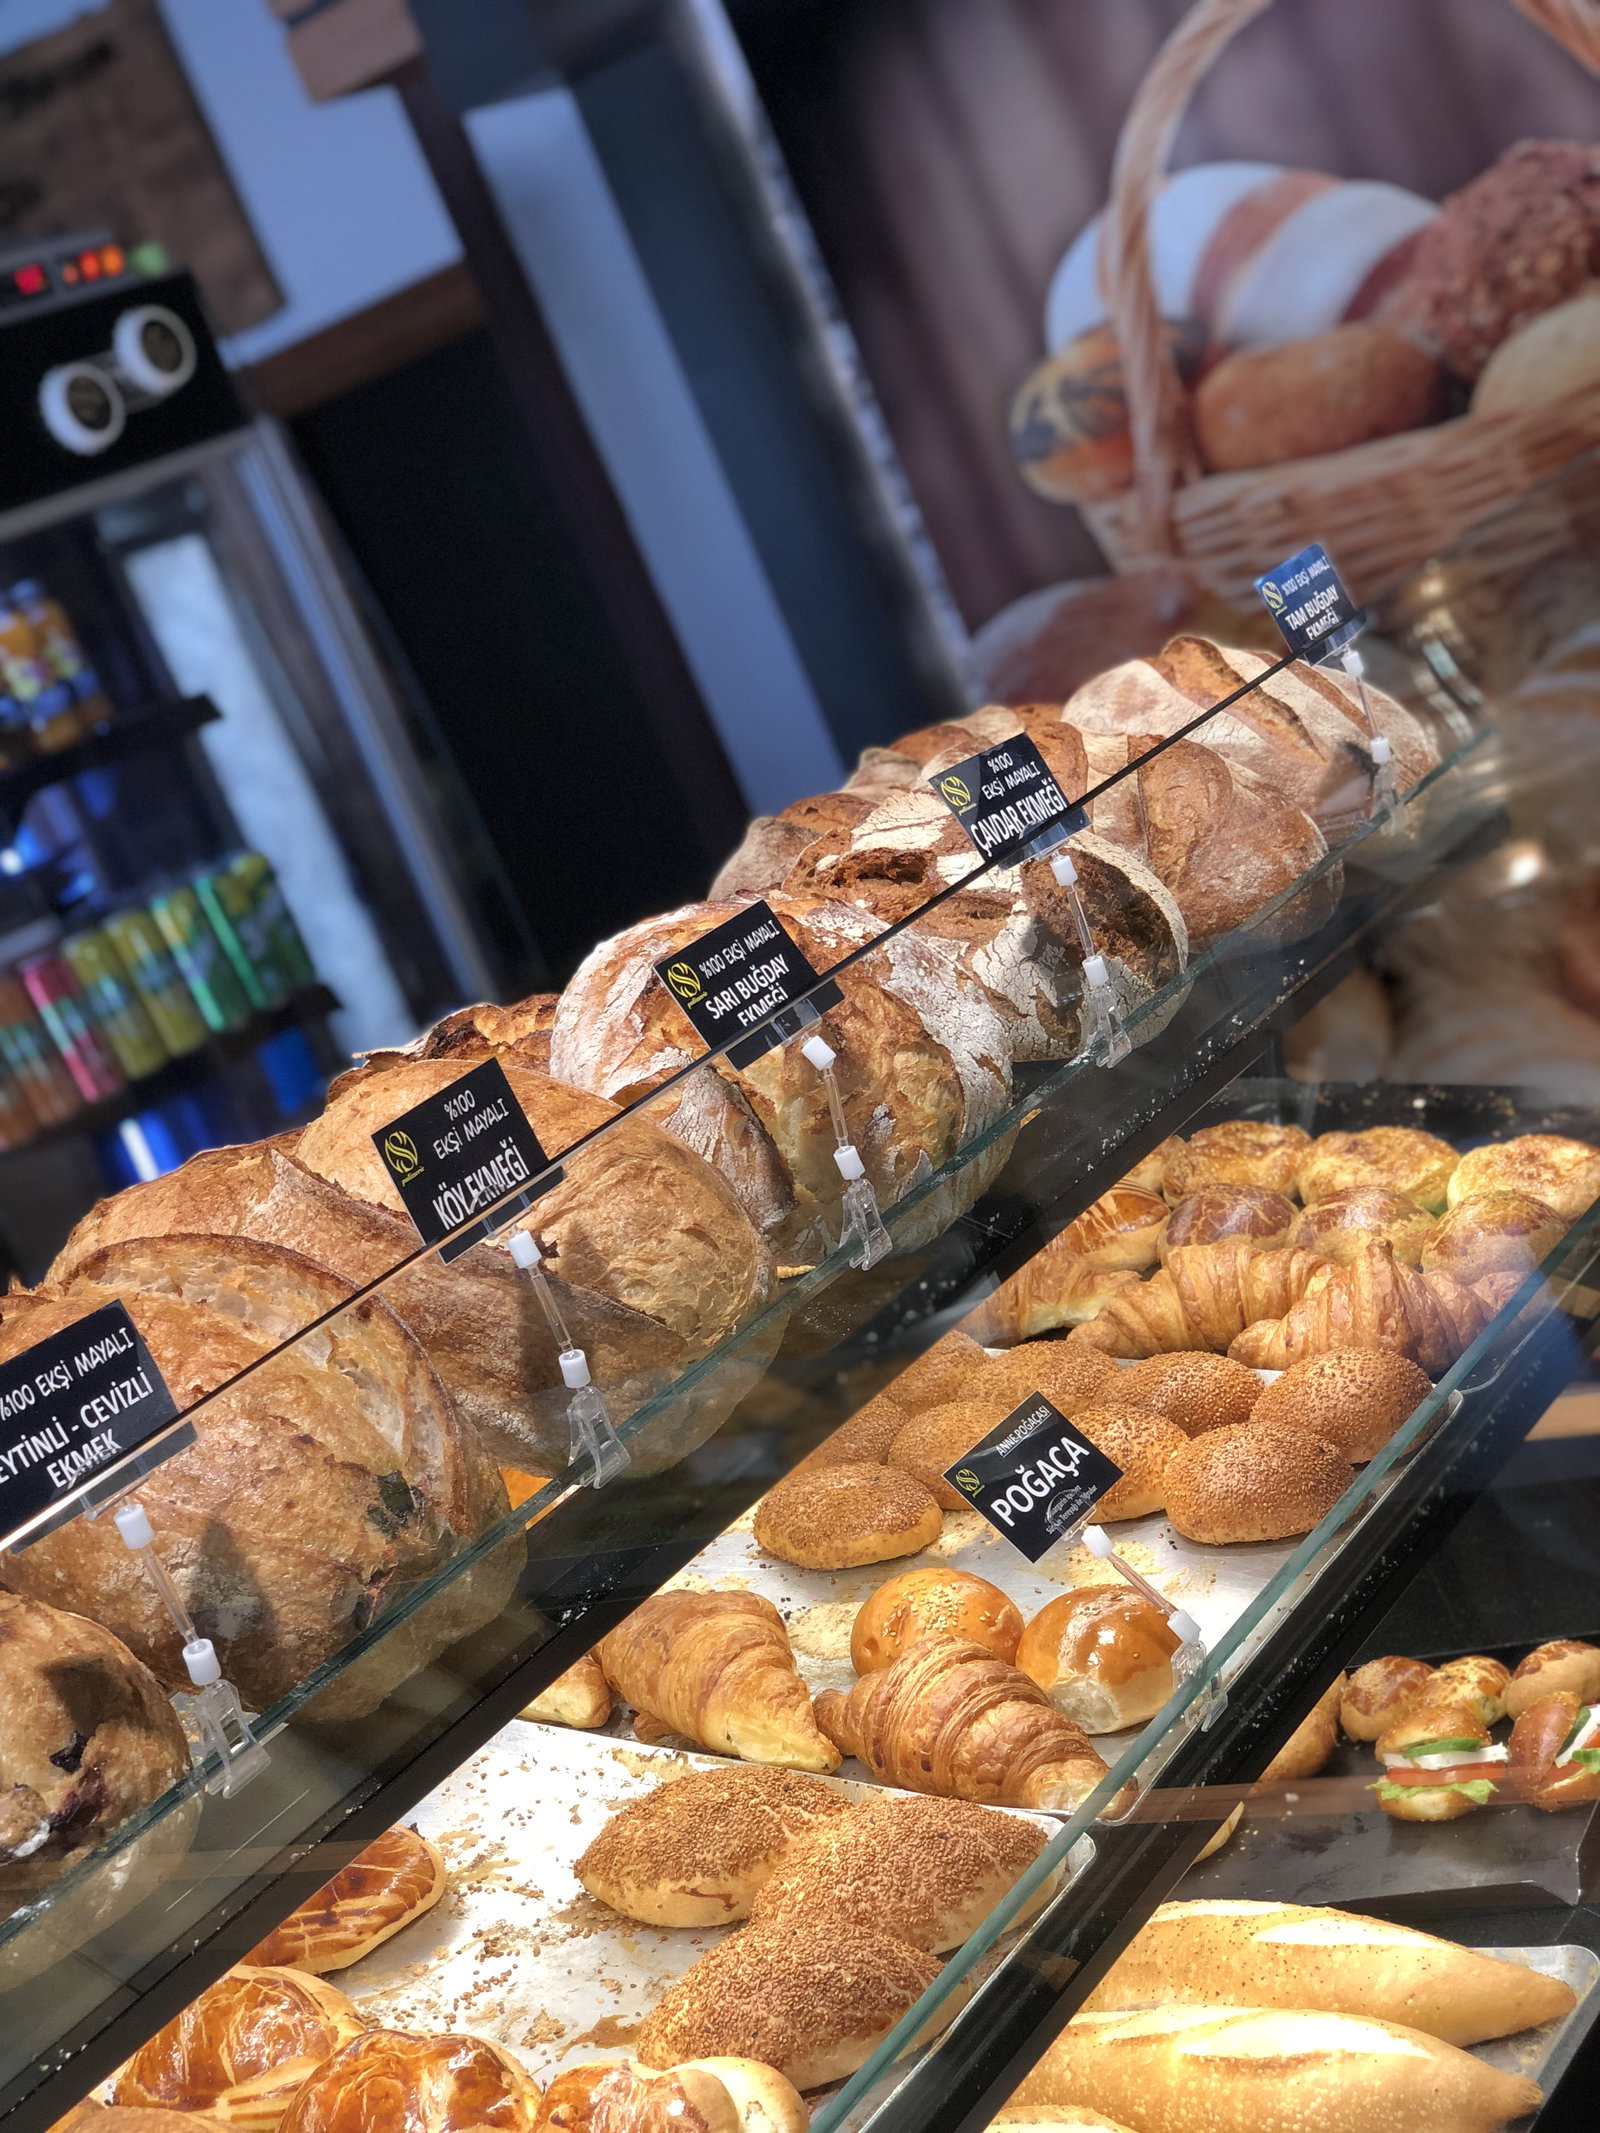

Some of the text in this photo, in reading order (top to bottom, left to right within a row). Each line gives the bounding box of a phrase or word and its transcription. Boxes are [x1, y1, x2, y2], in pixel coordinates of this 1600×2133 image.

[1285, 584, 1339, 631] TAM BUĞDAY
[982, 761, 1041, 800] EKŞİ MAYALI
[987, 752, 1013, 774] %100
[970, 777, 1067, 857] ÇAVDAR EKMEĞİ
[699, 919, 780, 980] %100 EKŞİ MAYALI
[705, 987, 741, 1020] SARI
[735, 953, 790, 1000] BUĞDAY
[432, 1098, 509, 1160] EKŞİ MAYALI
[443, 1089, 476, 1122] %100
[432, 1136, 531, 1230] KÖY EKMEĞİ
[35, 1360, 74, 1397] EKŞİ
[74, 1327, 135, 1377] MAYALI
[80, 1366, 154, 1429] CEVİZLİ
[46, 1429, 122, 1488] EKMEK
[996, 1405, 1050, 1456] ANNE POĞAÇASI
[990, 1436, 1090, 1527] POĞAÇA
